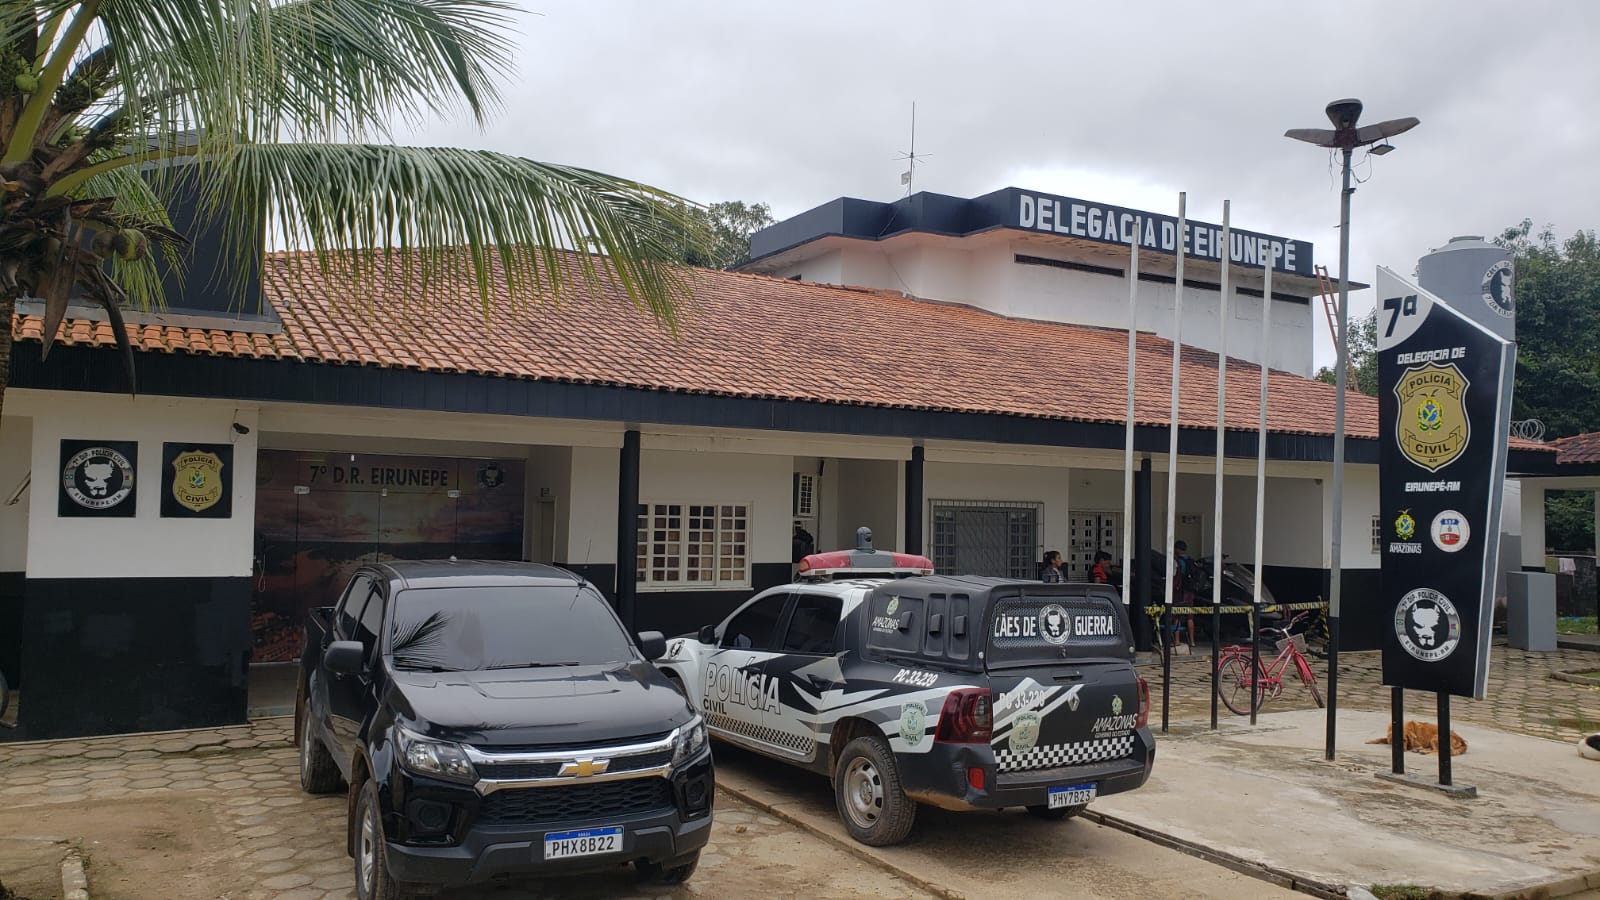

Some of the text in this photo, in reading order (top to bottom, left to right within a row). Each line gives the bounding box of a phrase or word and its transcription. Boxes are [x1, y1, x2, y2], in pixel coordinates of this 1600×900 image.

[1019, 194, 1157, 248] DELEGACIA
[1383, 294, 1417, 338] 7ª
[1396, 346, 1466, 365] DELEGACIA DE
[1409, 374, 1451, 389] POLÍCIA
[1415, 443, 1451, 455] CIVIL
[333, 467, 364, 484] D.R.
[371, 467, 448, 487] EIRUNEPE
[1405, 480, 1461, 492] EIRUNEPÉ-AM
[1389, 544, 1422, 554] AMAZONAS
[994, 613, 1020, 638] CÃES
[1022, 616, 1037, 637] DE
[1075, 616, 1114, 635] GUERRA
[892, 668, 911, 682] PC
[704, 656, 781, 715] POLÍCIA
[703, 698, 727, 714] CIVIL
[1091, 713, 1138, 733] AMAZONAS
[1053, 790, 1091, 806] PHY7B23
[552, 836, 614, 856] PHX8B22
